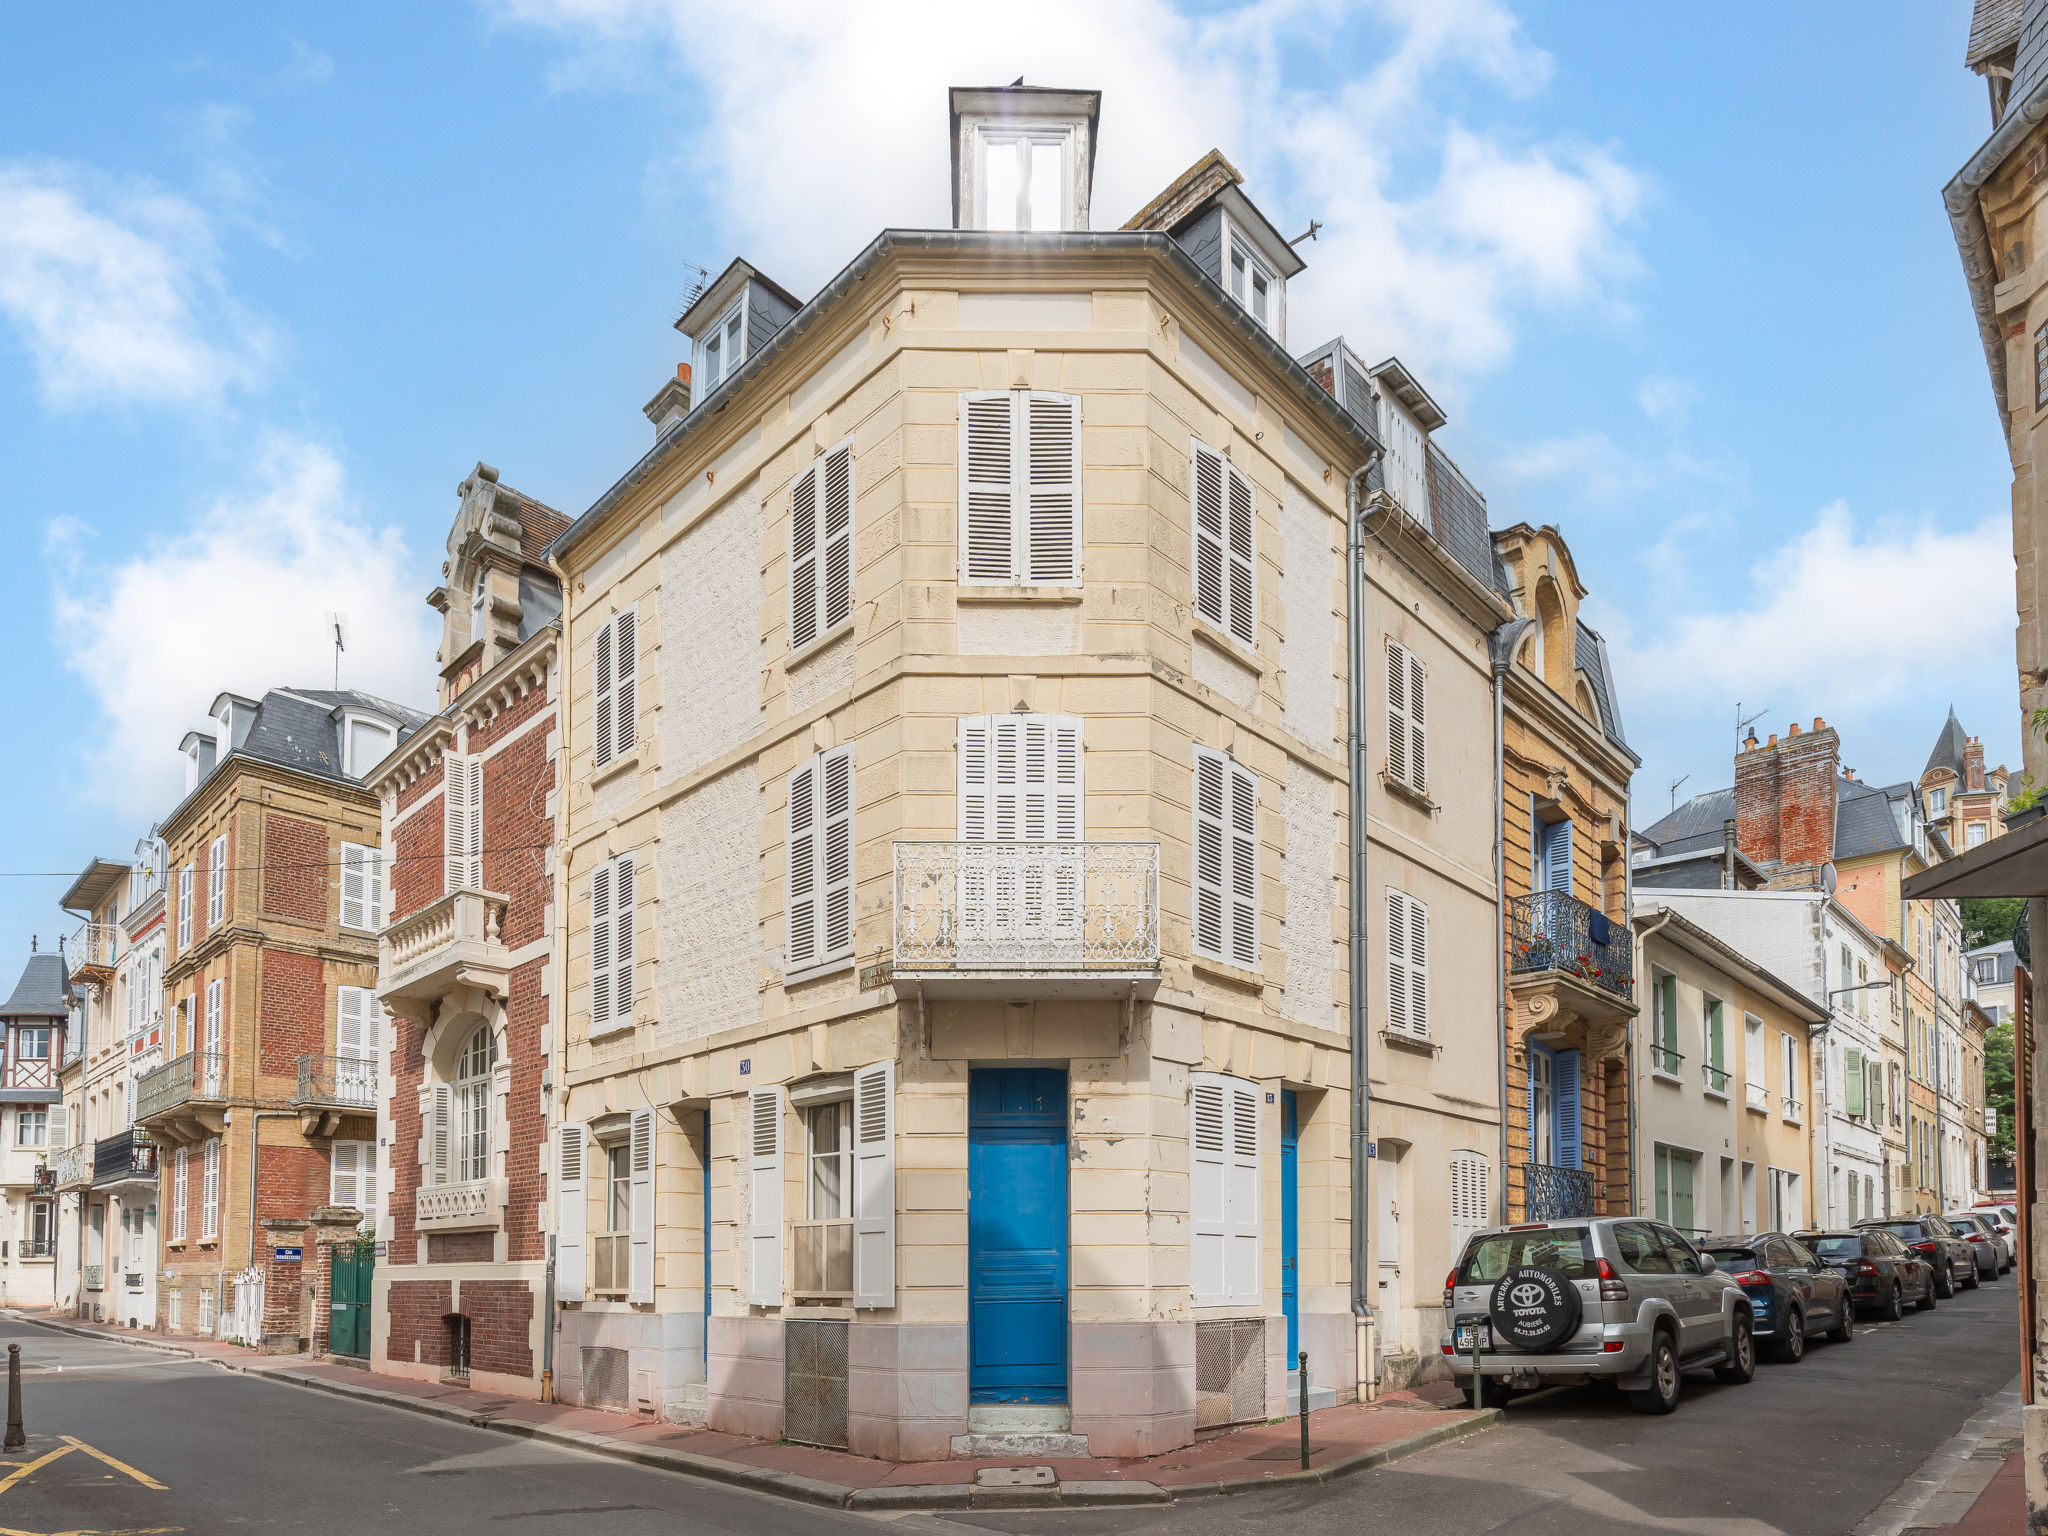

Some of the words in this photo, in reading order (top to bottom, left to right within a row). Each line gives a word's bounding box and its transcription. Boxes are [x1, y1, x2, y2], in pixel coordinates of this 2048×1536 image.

[740, 1060, 750, 1073] 30
[1497, 1276, 1514, 1312] ARVERNE
[1518, 1269, 1562, 1306] AUTOMOBILES
[1513, 1306, 1547, 1317] TOYOTA
